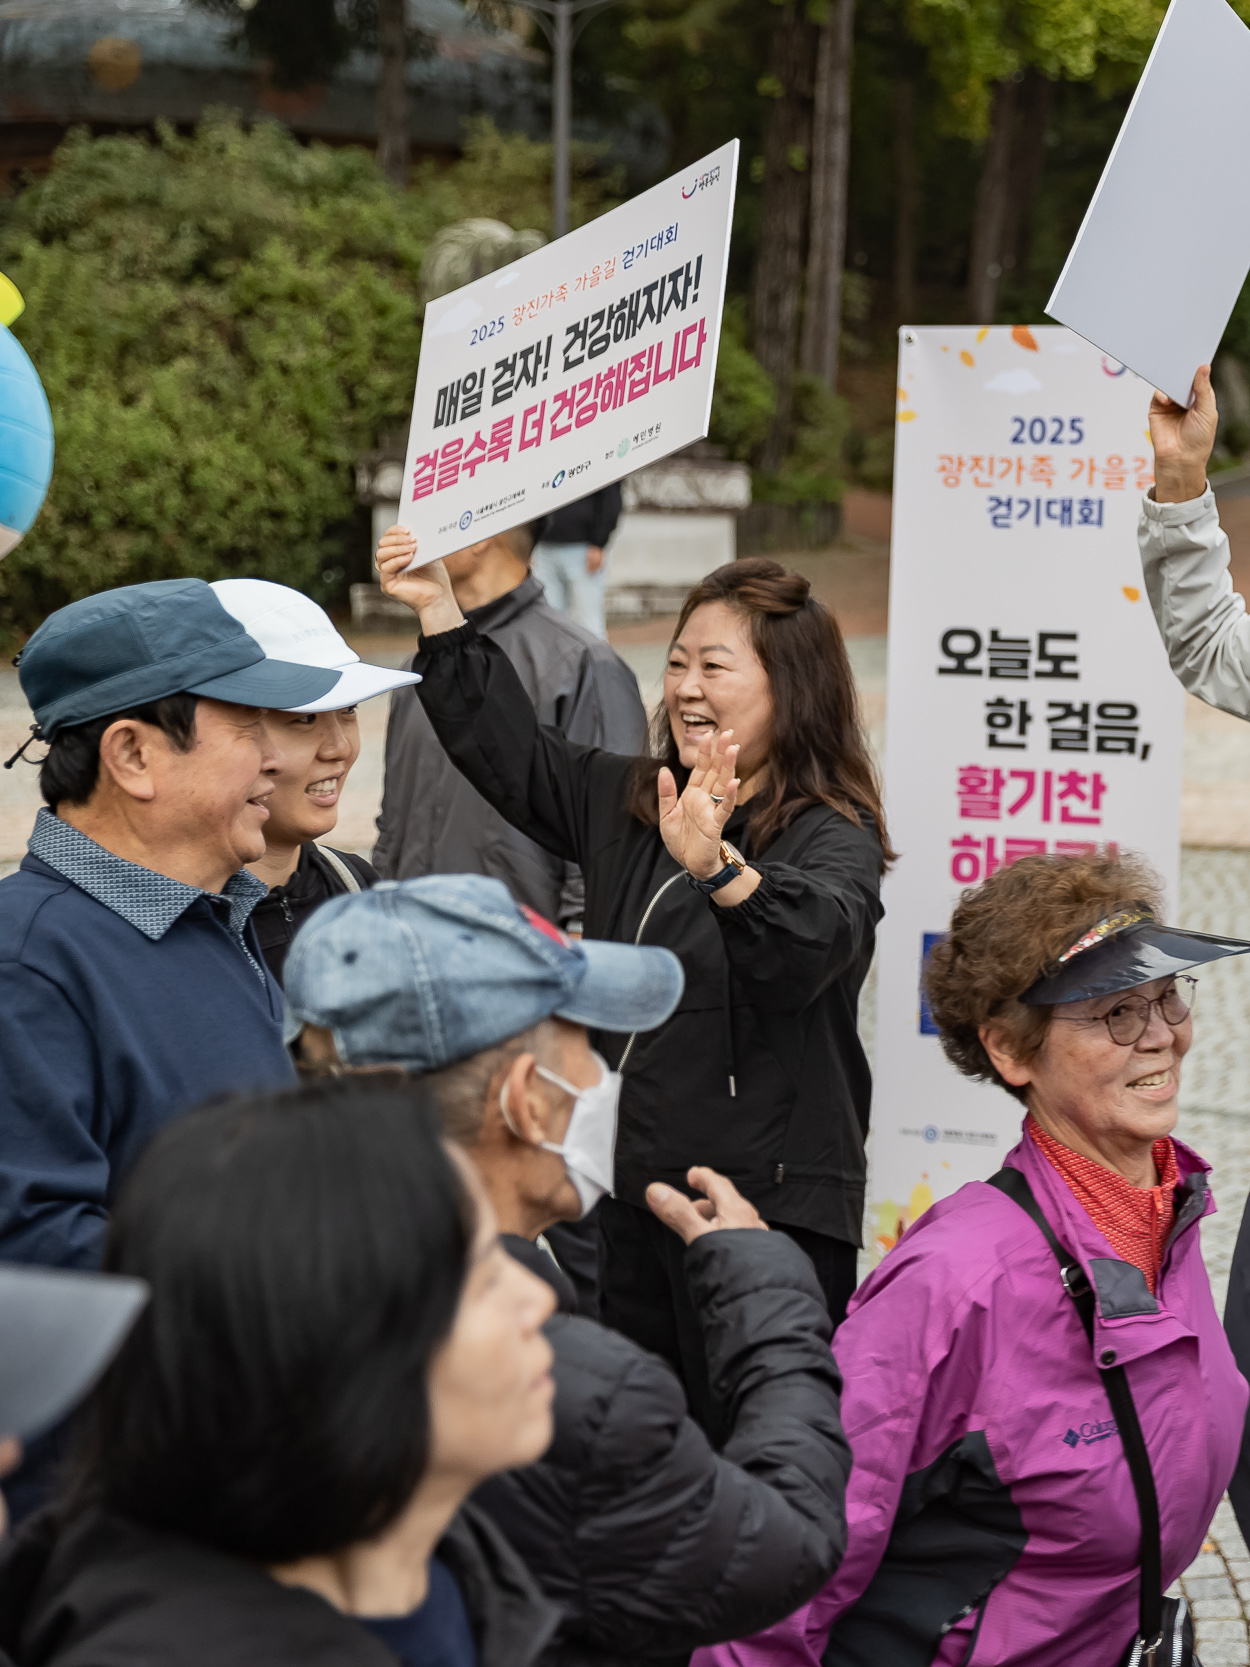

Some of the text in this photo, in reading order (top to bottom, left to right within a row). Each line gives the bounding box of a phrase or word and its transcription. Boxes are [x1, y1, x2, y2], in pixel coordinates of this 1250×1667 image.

[470, 222, 679, 346] 2025 광진가족 가을길 걷기대회
[433, 254, 704, 430] 매일 걷자! 건강해지자!
[412, 317, 708, 502] 걸을수록 더 건강해집니다
[1011, 417, 1084, 445] 2025
[936, 454, 1056, 490] 광진가족
[986, 496, 1104, 529] 걷기대회
[937, 628, 1080, 680] 오늘도
[985, 698, 1153, 761] 한 걸음,
[956, 764, 1108, 825] 활기찬
